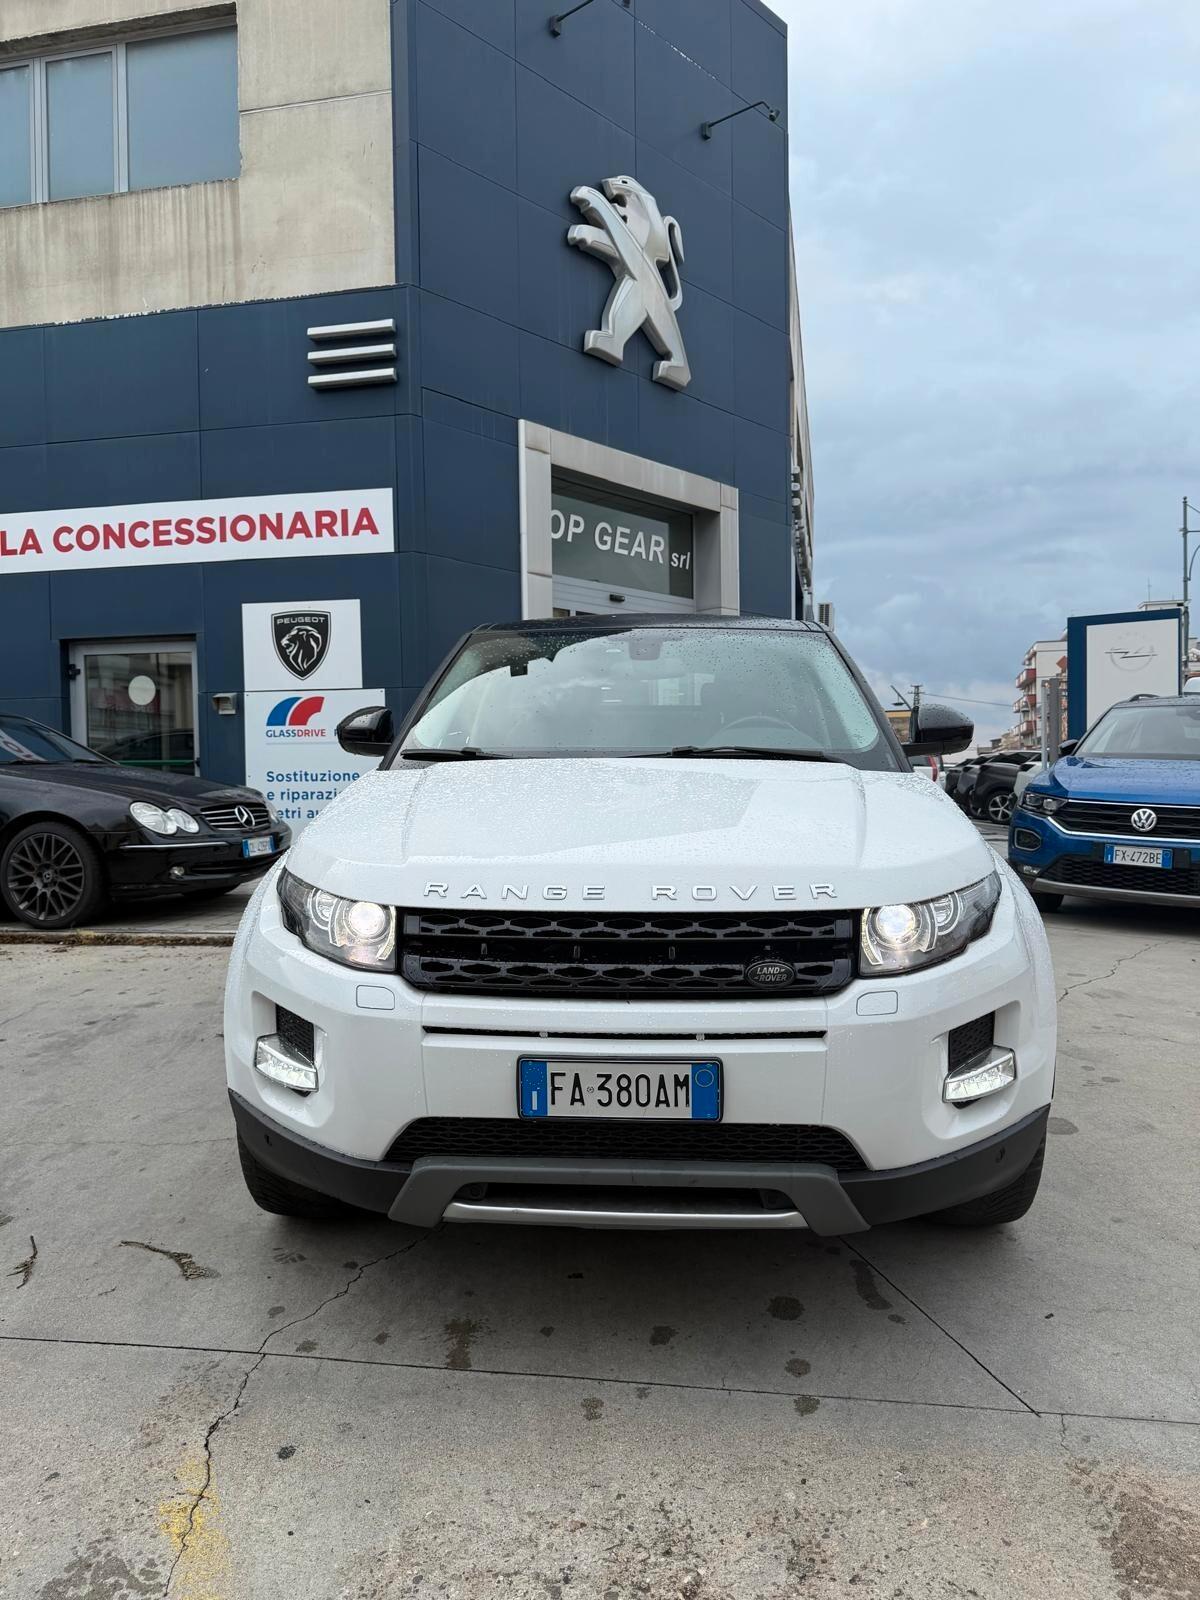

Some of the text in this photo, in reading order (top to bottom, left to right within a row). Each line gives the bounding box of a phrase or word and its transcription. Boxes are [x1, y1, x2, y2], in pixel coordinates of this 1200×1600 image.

[0, 507, 380, 556] LA CONCESSIONARIA
[551, 509, 691, 570] OP GEAR srl
[276, 616, 326, 625] PEUGEOT
[265, 728, 327, 738] GLASSDRIVE
[266, 770, 360, 783] Sostituzione
[267, 788, 341, 803] e riparazi
[276, 807, 301, 819] etri
[423, 881, 838, 901] RANGE ROVER
